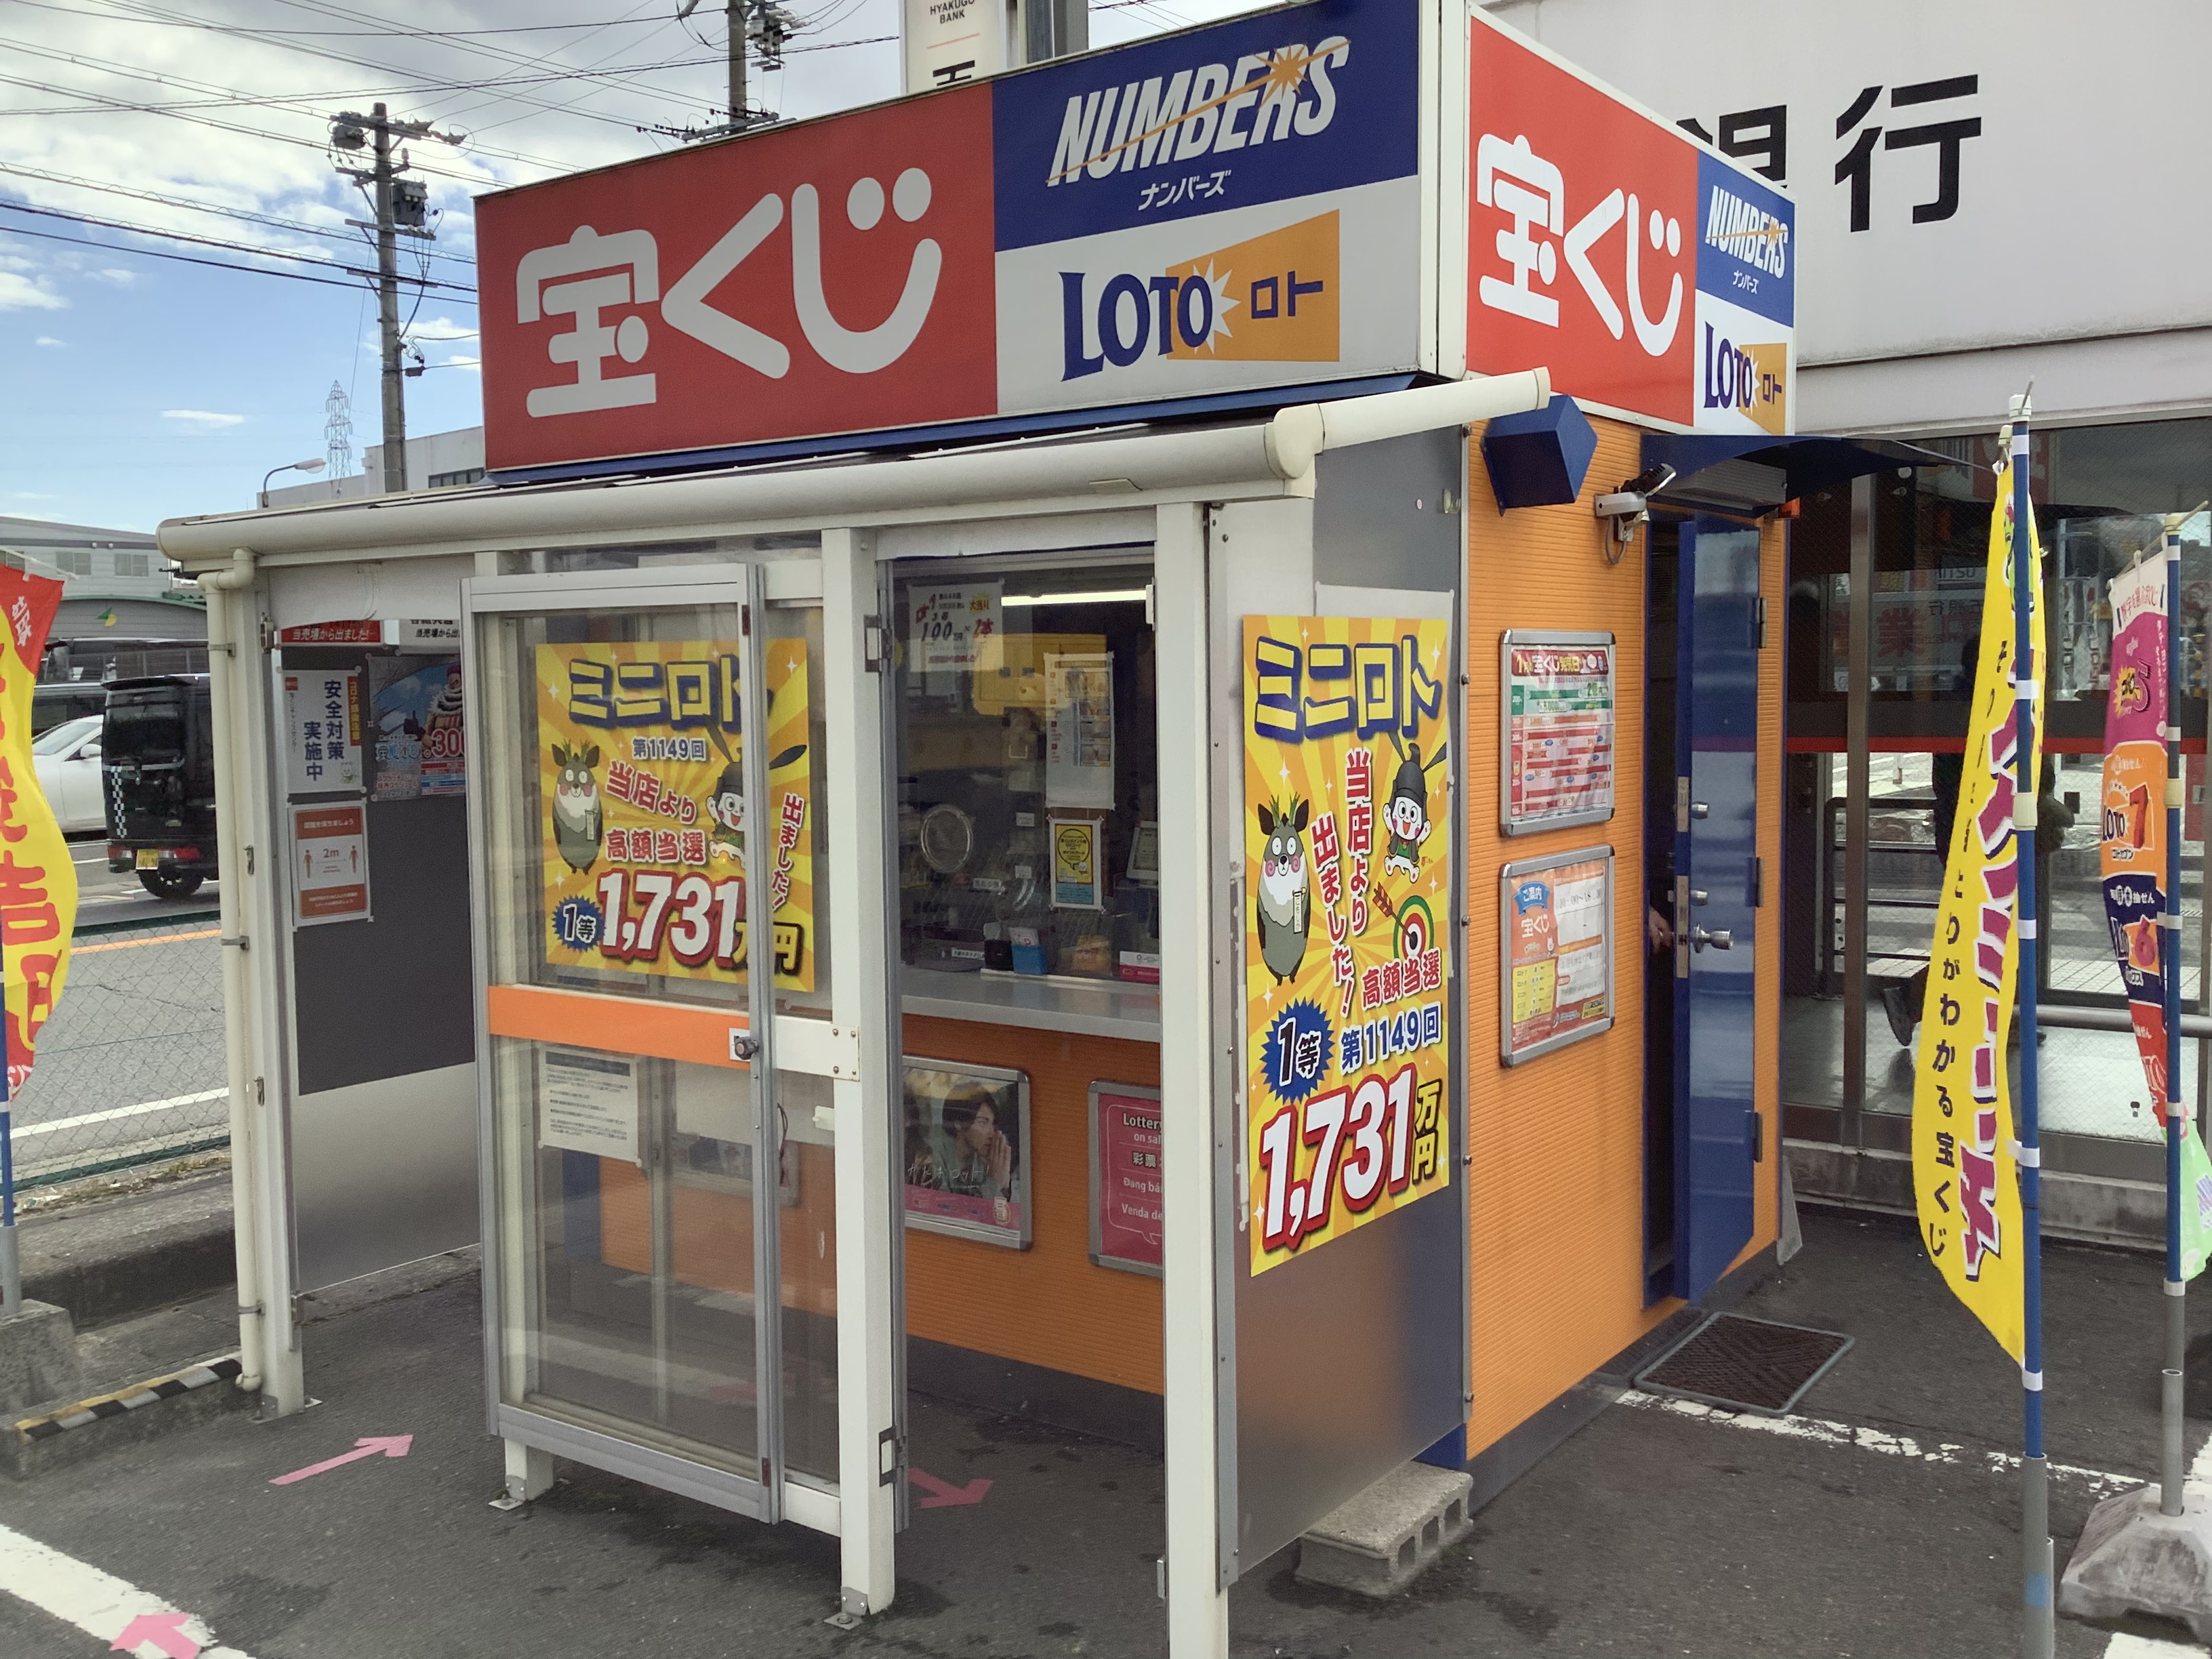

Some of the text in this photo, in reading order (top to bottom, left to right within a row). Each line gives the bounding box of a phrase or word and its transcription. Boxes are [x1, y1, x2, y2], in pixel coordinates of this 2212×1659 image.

[939, 9, 965, 24] BANK
[1046, 35, 1351, 186] NUMBERS
[1137, 169, 1232, 211] ナンバーズ
[1476, 133, 1683, 357] 宝くじ
[1704, 185, 1789, 279] NUMBERS
[516, 167, 942, 418] 宝くじ
[1733, 269, 1760, 295] ナンバーズ
[1058, 270, 1324, 382] LOTO ロト
[1703, 320, 1783, 409] LOTO ロト
[415, 628, 460, 638] 当売場から出
[324, 678, 344, 760] 安全対策
[1254, 634, 1442, 744] ミニロト
[303, 720, 323, 781] 実施中
[431, 728, 464, 758] 30
[632, 737, 706, 760] 第1149回
[605, 760, 697, 824] 当店より
[323, 848, 340, 858] 2m
[605, 829, 705, 864] 高額当選
[1345, 747, 1372, 936] 当店より
[562, 903, 597, 944] 1等
[1309, 811, 1355, 1018] 出ました!
[1521, 914, 1550, 939] 宝くじ
[1361, 947, 1442, 1011] 高額当選
[1277, 1017, 1322, 1087] 1等
[1340, 1001, 1442, 1076] 第1149回
[1132, 1151, 1157, 1168] 彩票
[1133, 1132, 1146, 1143] on
[1121, 1202, 1149, 1219] Venda
[1148, 1181, 1162, 1193] bá
